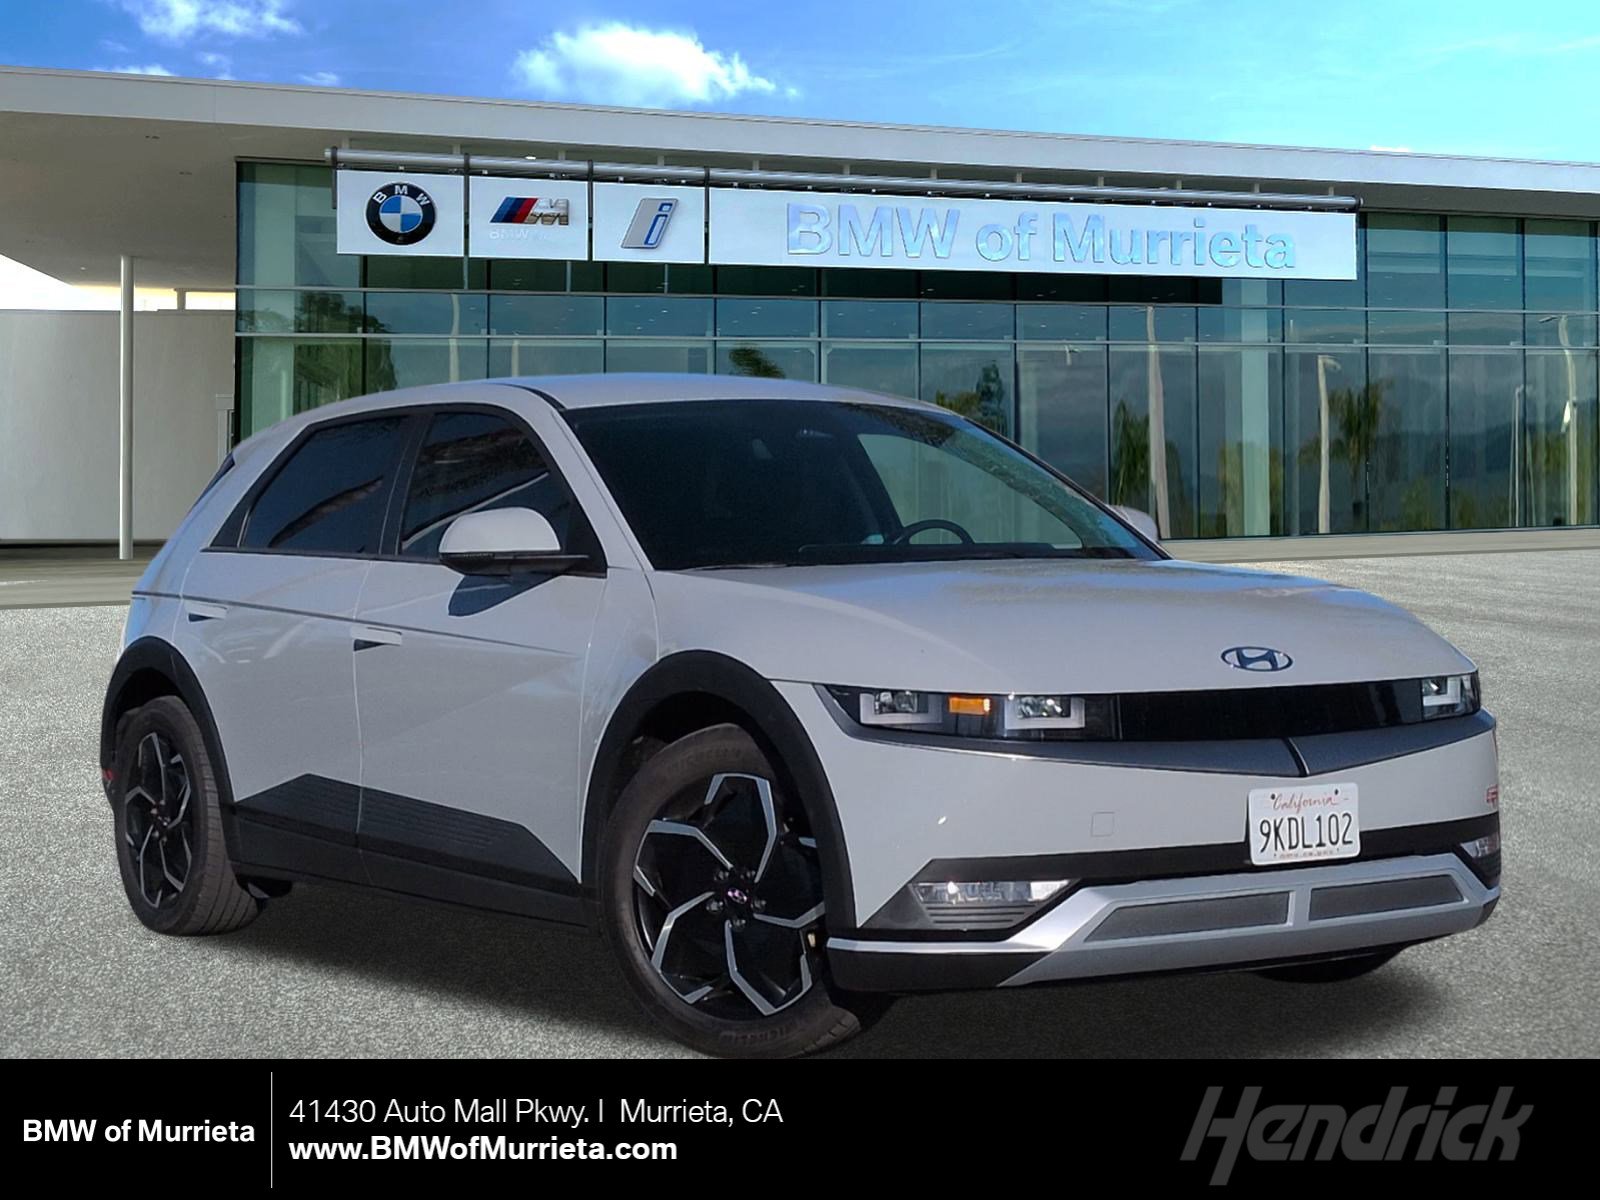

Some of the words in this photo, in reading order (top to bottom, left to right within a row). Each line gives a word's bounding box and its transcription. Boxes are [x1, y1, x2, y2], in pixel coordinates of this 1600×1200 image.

[371, 184, 431, 206] BMW
[786, 202, 961, 259] BMW
[976, 212, 1039, 262] of
[1052, 212, 1297, 270] Murrieta
[1272, 793, 1341, 813] California
[1259, 812, 1354, 853] 9KDL102
